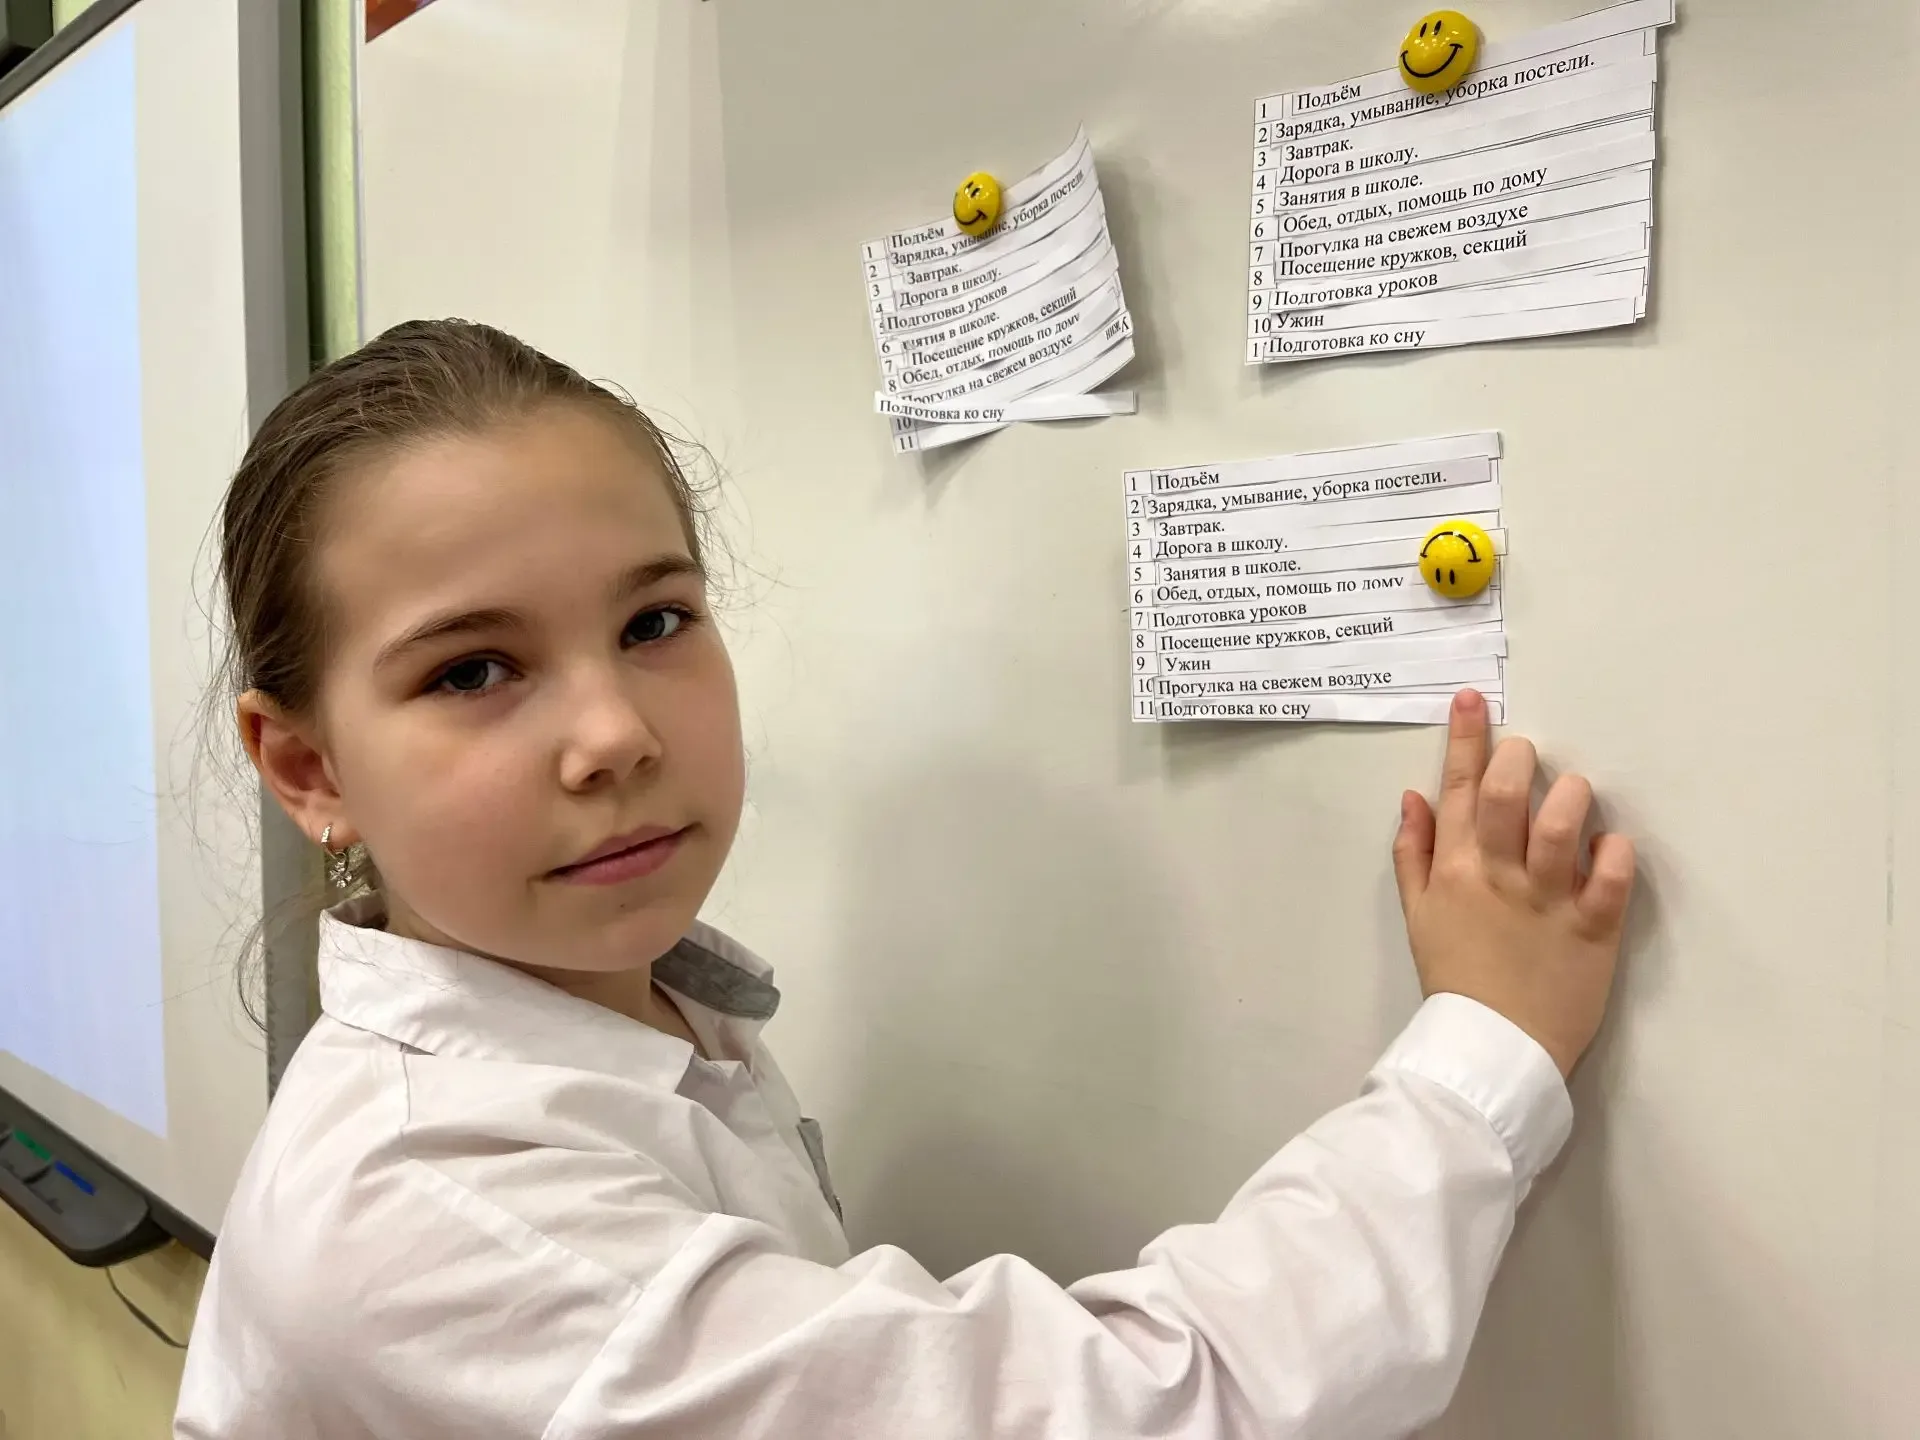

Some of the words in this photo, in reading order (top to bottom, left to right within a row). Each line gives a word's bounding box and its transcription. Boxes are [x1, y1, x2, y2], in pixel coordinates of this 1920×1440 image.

[1258, 126, 1267, 142] 2
[1275, 114, 1346, 139] Зарядка,
[1350, 91, 1439, 127] умывание,
[1445, 75, 1509, 106] уборка
[1515, 55, 1595, 86] постели.
[1260, 103, 1267, 119] 1
[1298, 84, 1362, 111] Подъём
[1257, 152, 1267, 166] 3
[1285, 137, 1354, 161] Завтрак.
[1257, 175, 1266, 190] 4
[1280, 161, 1340, 185] Дорога
[1345, 159, 1354, 171] в
[1359, 147, 1418, 170] школу.
[1254, 222, 1264, 237] 6
[1283, 213, 1332, 234] Обед,
[1337, 204, 1393, 224] отдых,
[1398, 187, 1467, 213] помощь
[1473, 180, 1494, 197] по
[1499, 167, 1548, 192] дому
[1256, 198, 1264, 213] 5
[1279, 185, 1346, 207] Занятия
[1351, 184, 1360, 197] в
[1364, 173, 1424, 196] школе.
[867, 246, 873, 258] 1
[892, 227, 945, 249] Подъём
[870, 265, 878, 278] 2
[890, 246, 949, 265] Зарядка,
[1013, 200, 1049, 230] уборка
[1254, 246, 1264, 262] 7
[1364, 232, 1383, 246] на
[1388, 220, 1451, 243] свежем
[1457, 205, 1528, 230] воздухе
[1253, 270, 1262, 285] 8
[1280, 255, 1375, 277] Посещение
[1380, 245, 1457, 271] кружков,
[1463, 230, 1527, 254] секций
[872, 284, 880, 297] 3
[907, 264, 962, 284] Завтрак.
[899, 287, 948, 307] Дорога
[952, 284, 959, 294] в
[962, 268, 1001, 290] школу.
[1252, 295, 1262, 310] 9
[1275, 283, 1372, 306] Подготовка
[1377, 272, 1438, 298] уроков
[887, 303, 965, 330] Подготовка
[968, 285, 1008, 313] уроков
[1253, 318, 1271, 333] 10
[1277, 312, 1324, 329] Ужин
[881, 340, 890, 353] 6
[949, 328, 956, 338] в
[959, 312, 999, 335] школе.
[885, 360, 893, 371] 7
[912, 337, 985, 367] Посещение
[987, 313, 1038, 342] кружков,
[1040, 287, 1077, 316] секций
[1269, 334, 1364, 354] Подготовка
[1369, 333, 1389, 345] ко
[1394, 330, 1425, 347] сну
[888, 379, 897, 392] 8
[903, 367, 942, 384] Обед,
[946, 355, 985, 375] отдых,
[988, 335, 1035, 359] помощь
[1038, 328, 1052, 341] по
[969, 377, 983, 390] на
[986, 360, 1027, 383] свежем
[1029, 335, 1073, 363] воздухе
[880, 400, 960, 419] Подготовка
[964, 409, 979, 419] ко
[982, 407, 1004, 421] сну
[899, 436, 914, 450] 11
[1131, 477, 1137, 491] 1
[1157, 472, 1220, 492] Подъём
[1131, 500, 1139, 513] 2
[1148, 496, 1217, 515] Зарядка,
[1221, 486, 1307, 511] умывание,
[1312, 480, 1369, 501] уборка
[1374, 471, 1448, 491] постели.
[1132, 522, 1140, 536] 3
[1159, 520, 1225, 536] Завтрак.
[1132, 545, 1141, 558] 4
[1156, 540, 1212, 558] Дорога
[1217, 540, 1226, 551] в
[1230, 536, 1288, 553] школу.
[1134, 567, 1142, 581] 5
[1163, 565, 1226, 581] Занятия
[1231, 565, 1240, 577] в
[1245, 558, 1302, 575] школе.
[1134, 590, 1143, 603] 6
[1157, 585, 1202, 603] Обед,
[1207, 584, 1261, 599] отдых,
[1266, 581, 1332, 597] помощь
[1337, 579, 1357, 592] по
[1135, 612, 1143, 626] 7
[1153, 608, 1245, 628] Подготовка
[1250, 603, 1307, 622] уроков
[1136, 634, 1144, 648] 8
[1161, 633, 1250, 651] Посещение
[1255, 628, 1331, 648] кружков,
[1335, 617, 1394, 638] секций
[1136, 657, 1145, 670] 9
[1165, 657, 1211, 671] Ужин
[1158, 678, 1234, 697] Прогулка
[1239, 677, 1257, 690] на
[1262, 674, 1323, 690] свежем
[1328, 670, 1392, 687] воздухе
[1139, 701, 1153, 715] 11
[1161, 701, 1253, 718] Подготовка
[1259, 702, 1277, 715] ко
[1282, 701, 1311, 719] сну
